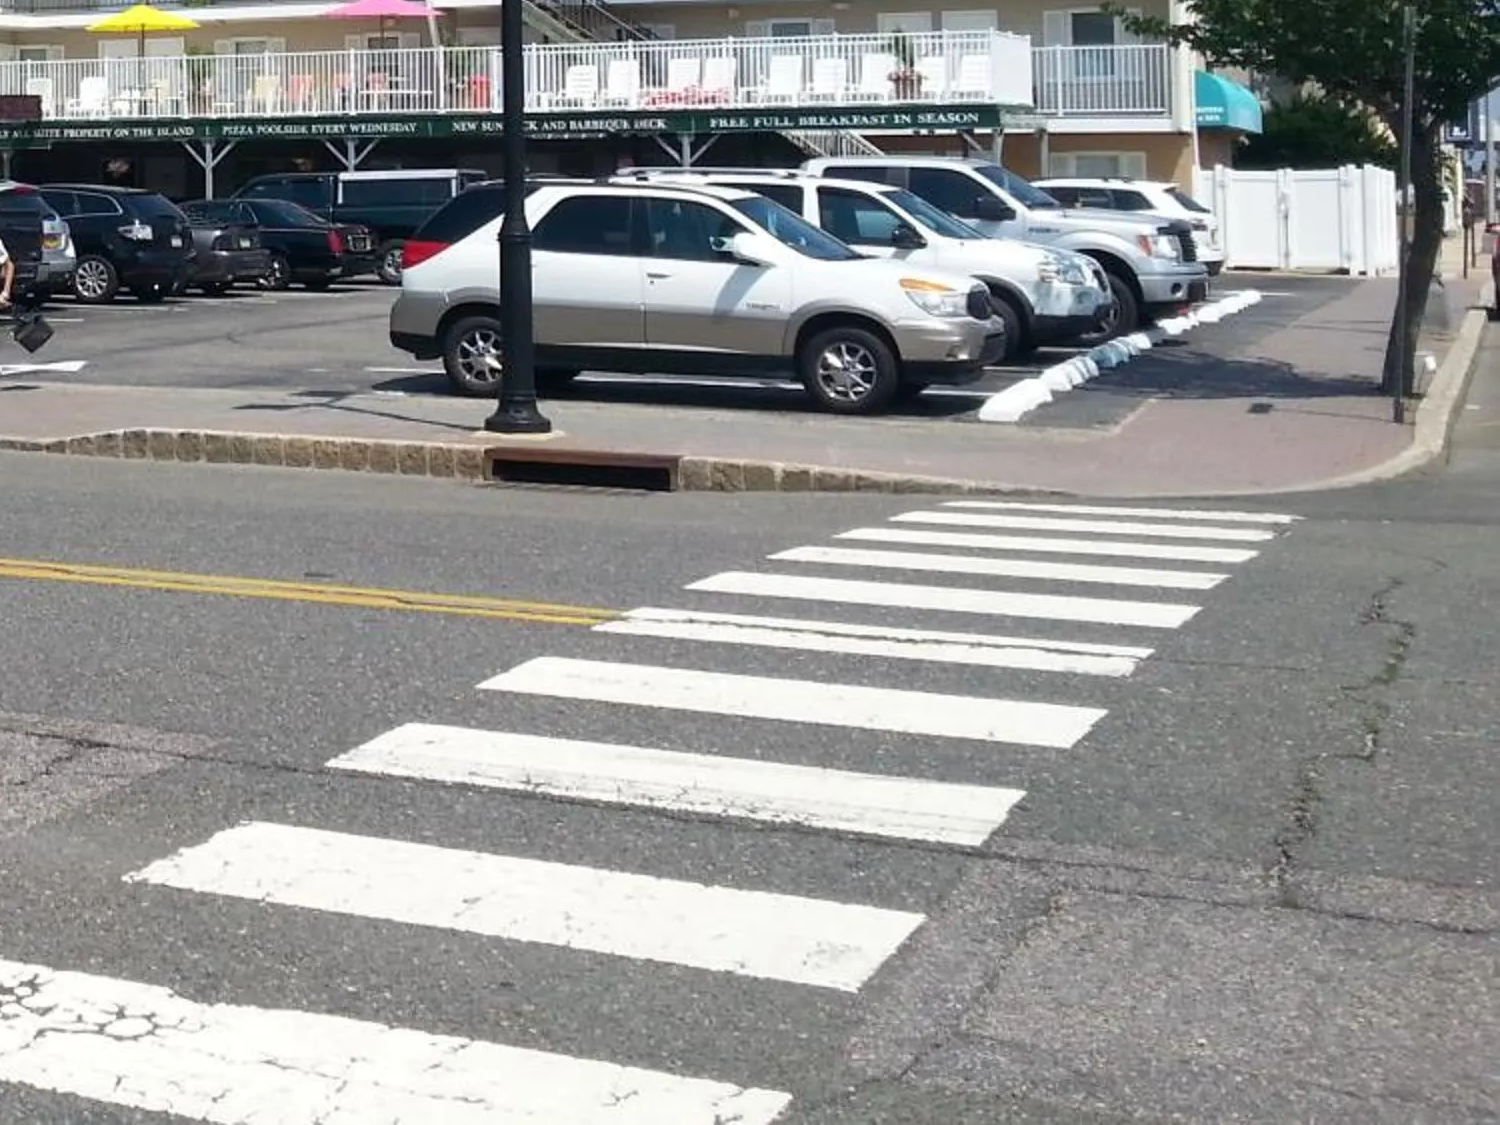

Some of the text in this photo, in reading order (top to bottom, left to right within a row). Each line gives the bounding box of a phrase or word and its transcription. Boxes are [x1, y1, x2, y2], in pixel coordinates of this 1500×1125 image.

[451, 121, 478, 132] NEW
[481, 121, 503, 132] SUN
[542, 120, 567, 130] AND
[569, 118, 630, 131] BARBEQUE
[633, 118, 667, 129] DECK
[709, 112, 980, 128] FREE FULL BREAKFAST IN SEASON
[63, 127, 113, 137] PROPERTY
[114, 127, 129, 137] ON
[132, 127, 154, 137] THE
[157, 126, 195, 136] ISLAND
[222, 122, 417, 135] PIZZA POOLSIDE EVERY WEDNESDAY
